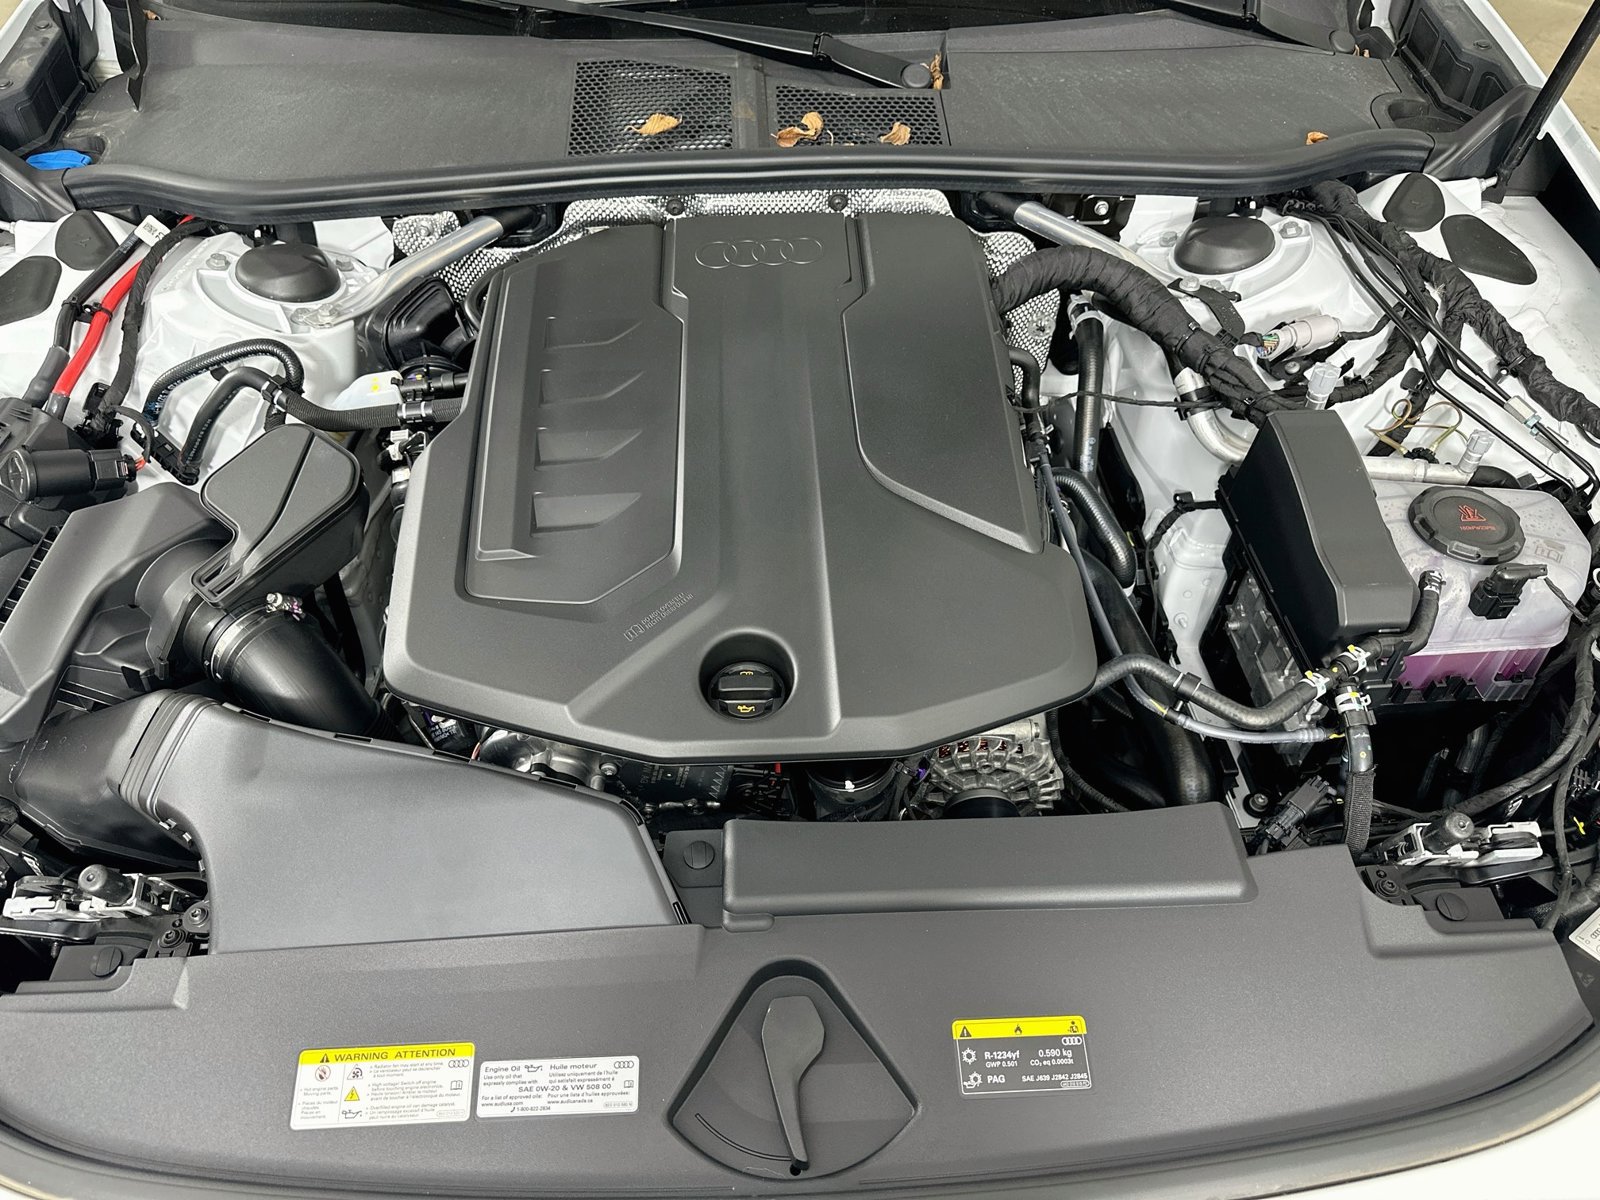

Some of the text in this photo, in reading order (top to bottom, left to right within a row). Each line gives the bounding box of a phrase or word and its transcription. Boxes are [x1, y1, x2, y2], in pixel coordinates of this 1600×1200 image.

[334, 1049, 456, 1061] WARNING ATTENTION
[984, 1050, 1020, 1060] R-1234yf
[1038, 1048, 1072, 1058] 0.590 kg
[1002, 1060, 1018, 1068] 0.501
[987, 1075, 1006, 1084] PAG
